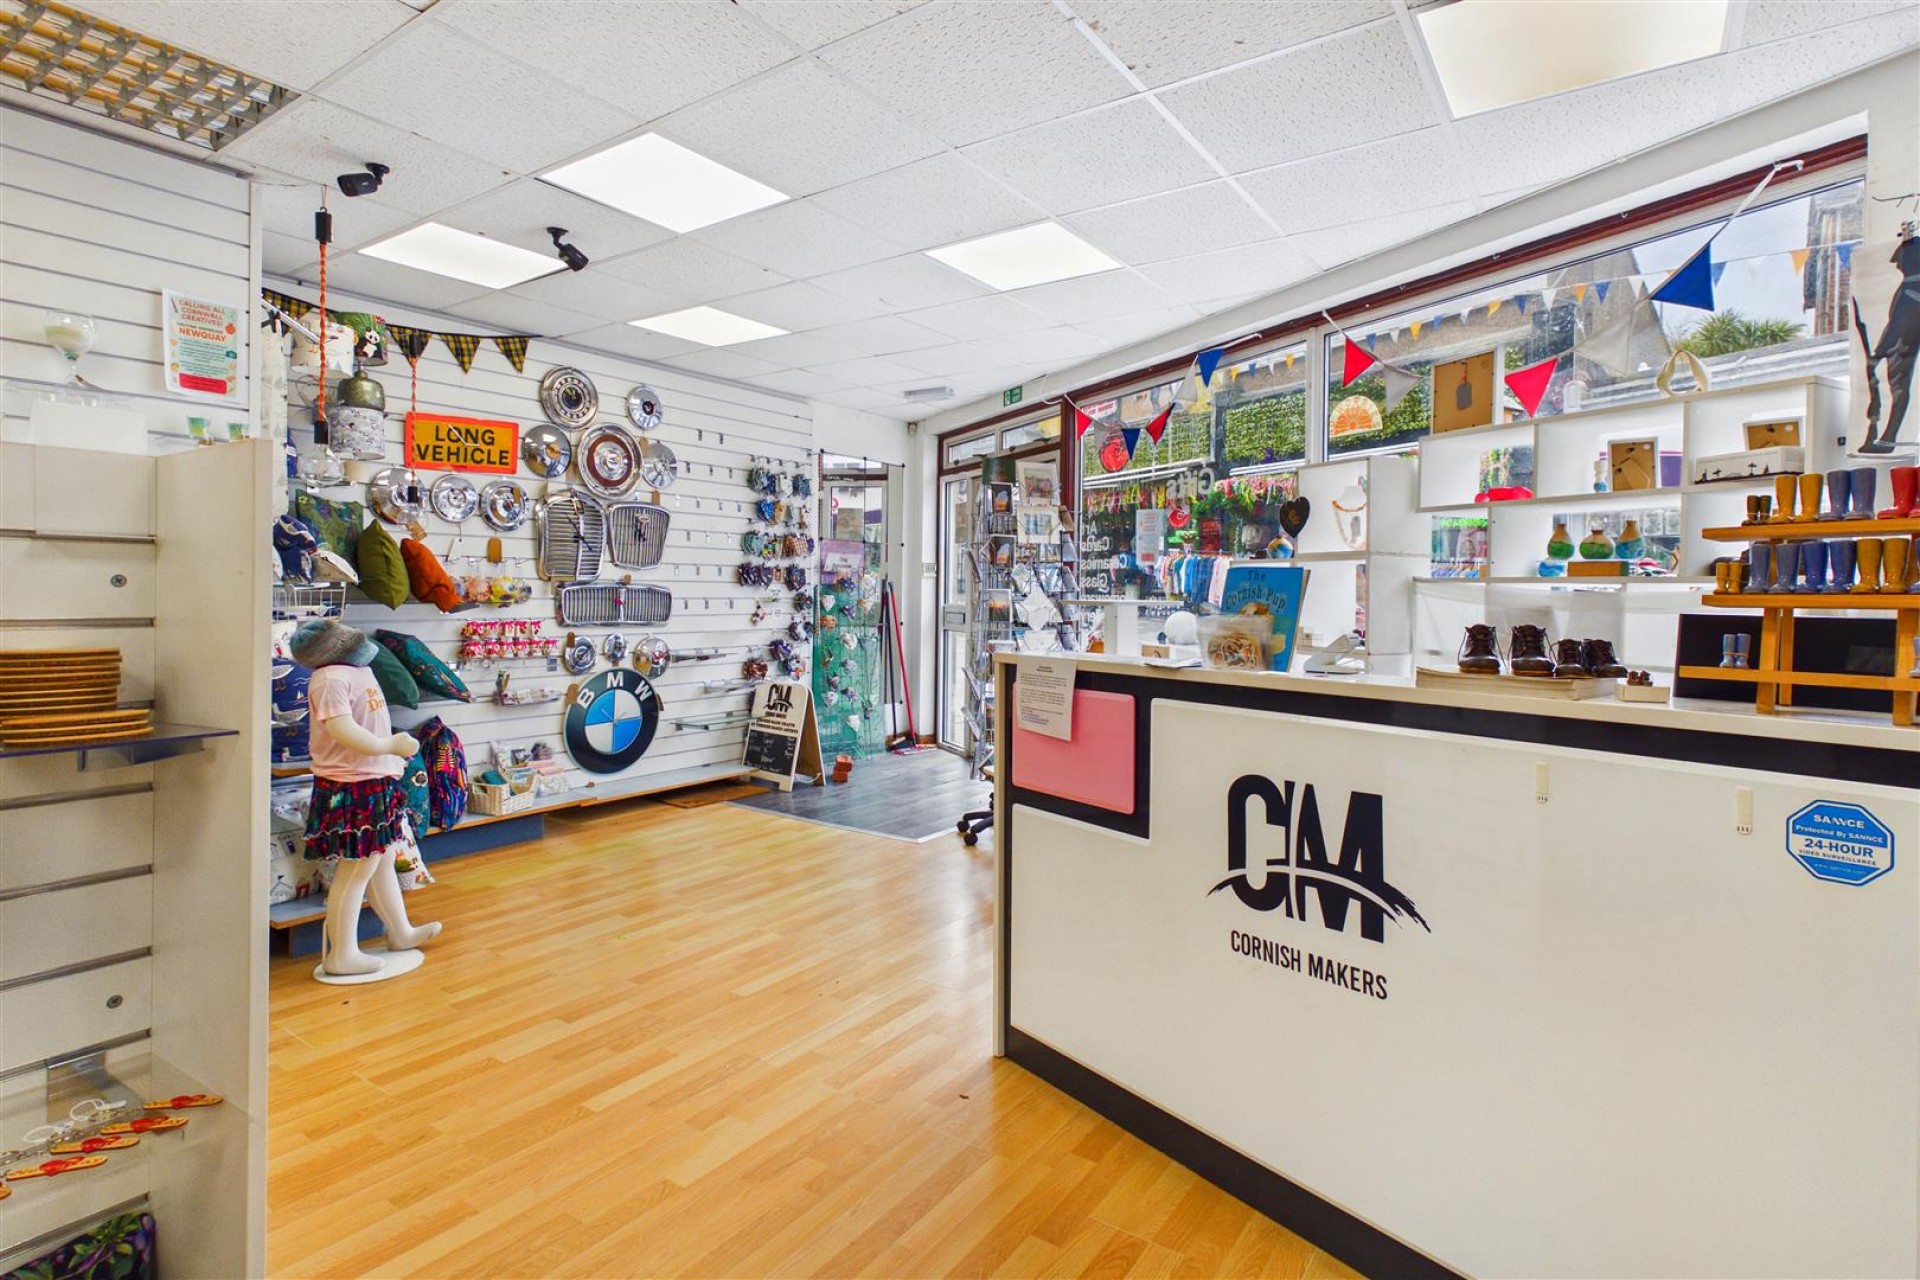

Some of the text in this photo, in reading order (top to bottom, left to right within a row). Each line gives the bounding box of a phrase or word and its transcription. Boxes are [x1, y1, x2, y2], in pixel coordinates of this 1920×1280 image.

[179, 327, 226, 342] NEWQUAY
[435, 425, 495, 446] LONG
[416, 443, 510, 466] VEHICLE
[1248, 570, 1267, 581] The
[577, 671, 653, 709] BMW
[1796, 824, 1884, 844] Protected By SANNCE
[1798, 849, 1877, 866] VIDEO SURVEILLANCE
[1804, 838, 1874, 858] 24-HOUR
[1230, 929, 1388, 1000] CORNISH MAKERS
